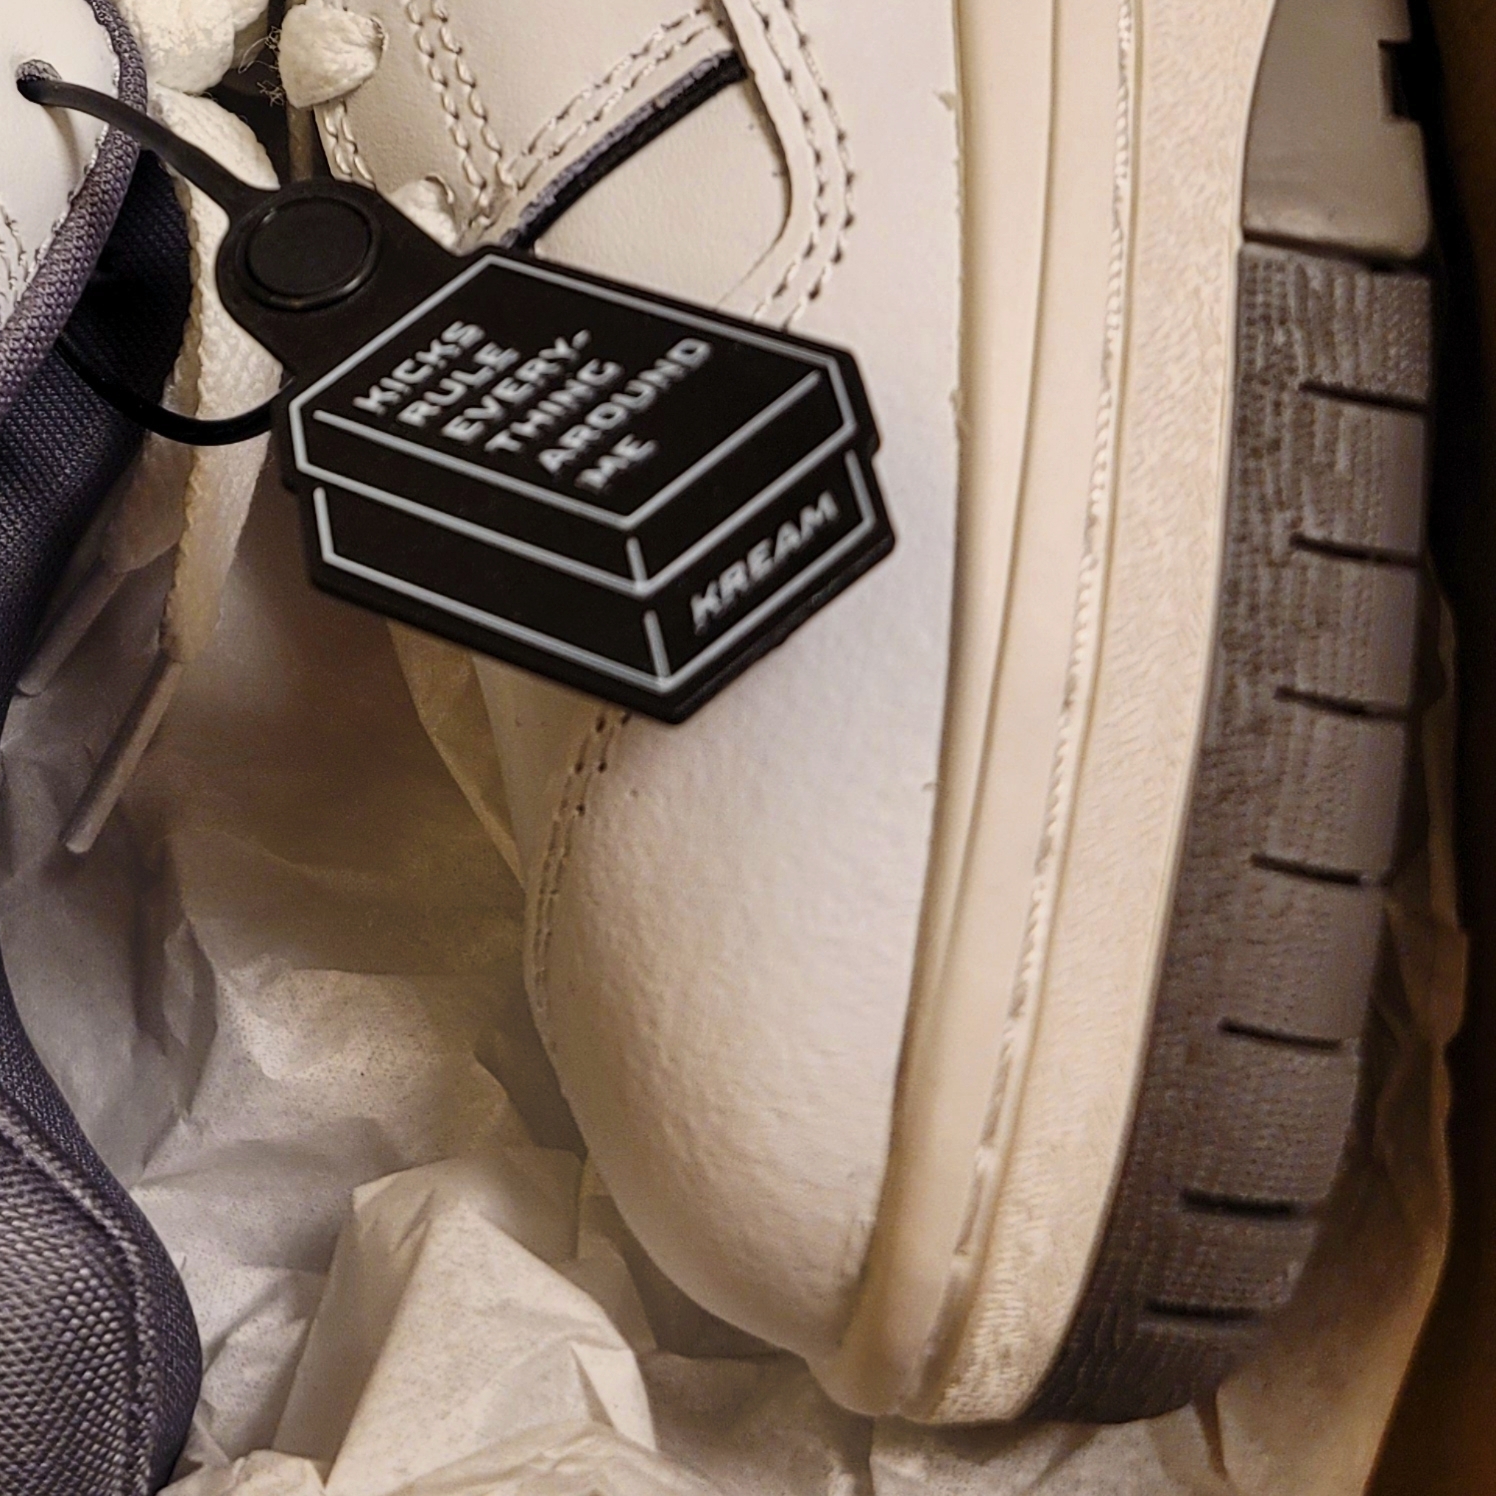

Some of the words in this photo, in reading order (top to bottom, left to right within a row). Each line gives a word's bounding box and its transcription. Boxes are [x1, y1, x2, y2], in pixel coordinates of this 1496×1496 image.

[355, 322, 484, 414] KICKS
[398, 342, 518, 425] RULE
[485, 359, 622, 451] THING
[539, 337, 711, 474] AROUND
[576, 434, 658, 491] ME
[691, 490, 838, 632] KREAM
